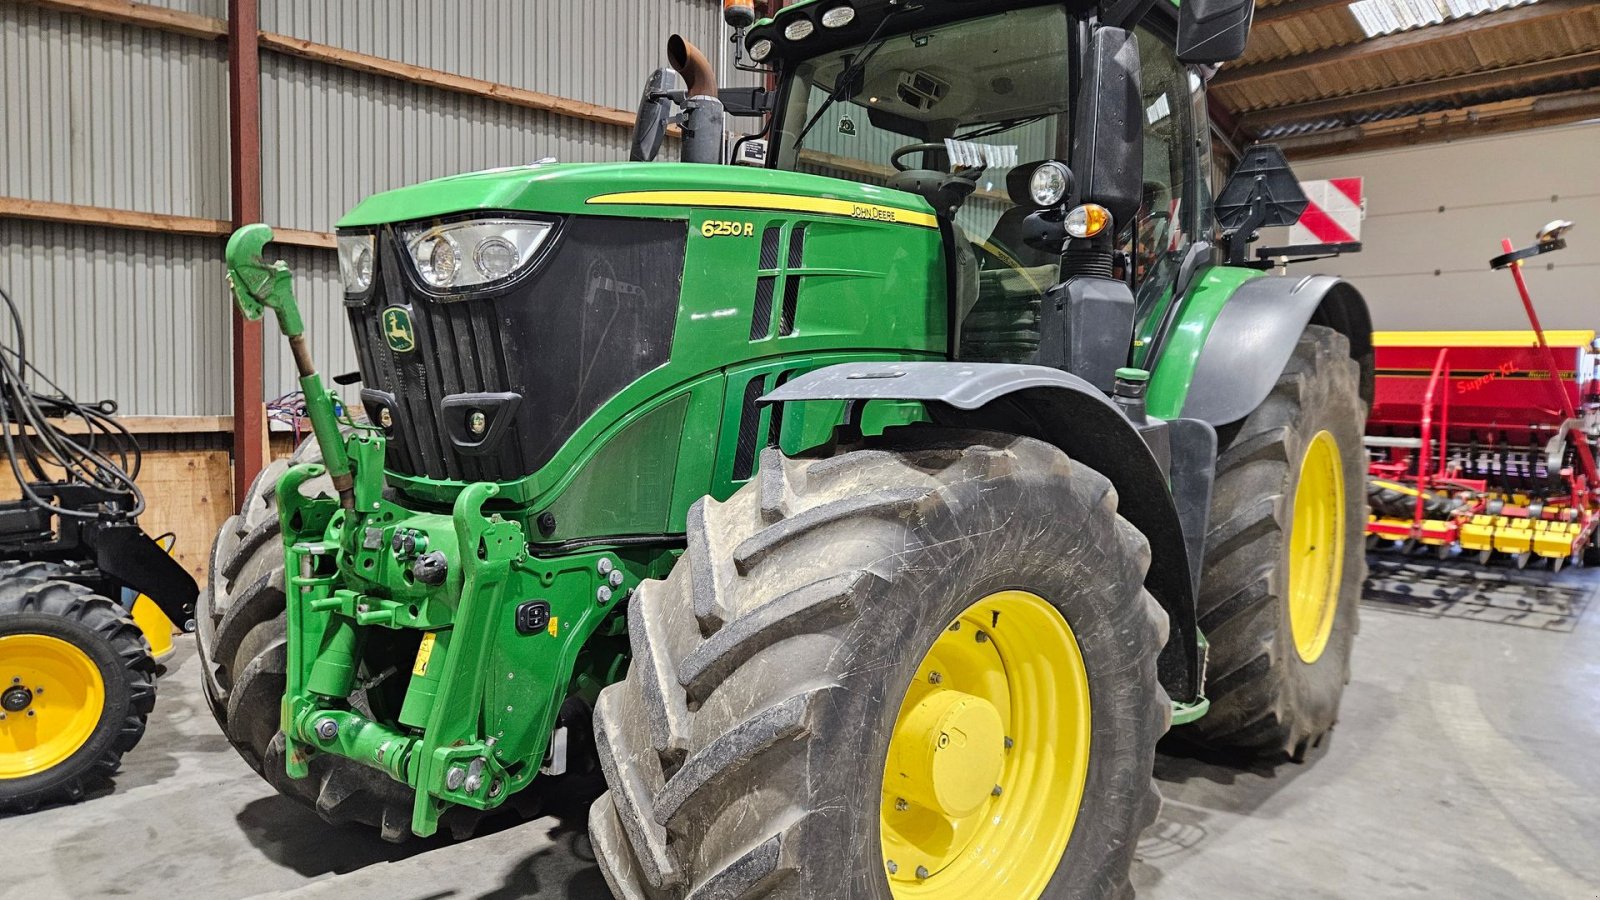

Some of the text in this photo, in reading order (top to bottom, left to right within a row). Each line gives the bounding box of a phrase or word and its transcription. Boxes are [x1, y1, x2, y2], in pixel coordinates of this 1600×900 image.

[851, 204, 896, 220] JOHN DEERE
[701, 220, 754, 238] 6250 R
[1457, 371, 1495, 393] Super
[1499, 361, 1519, 379] XL
